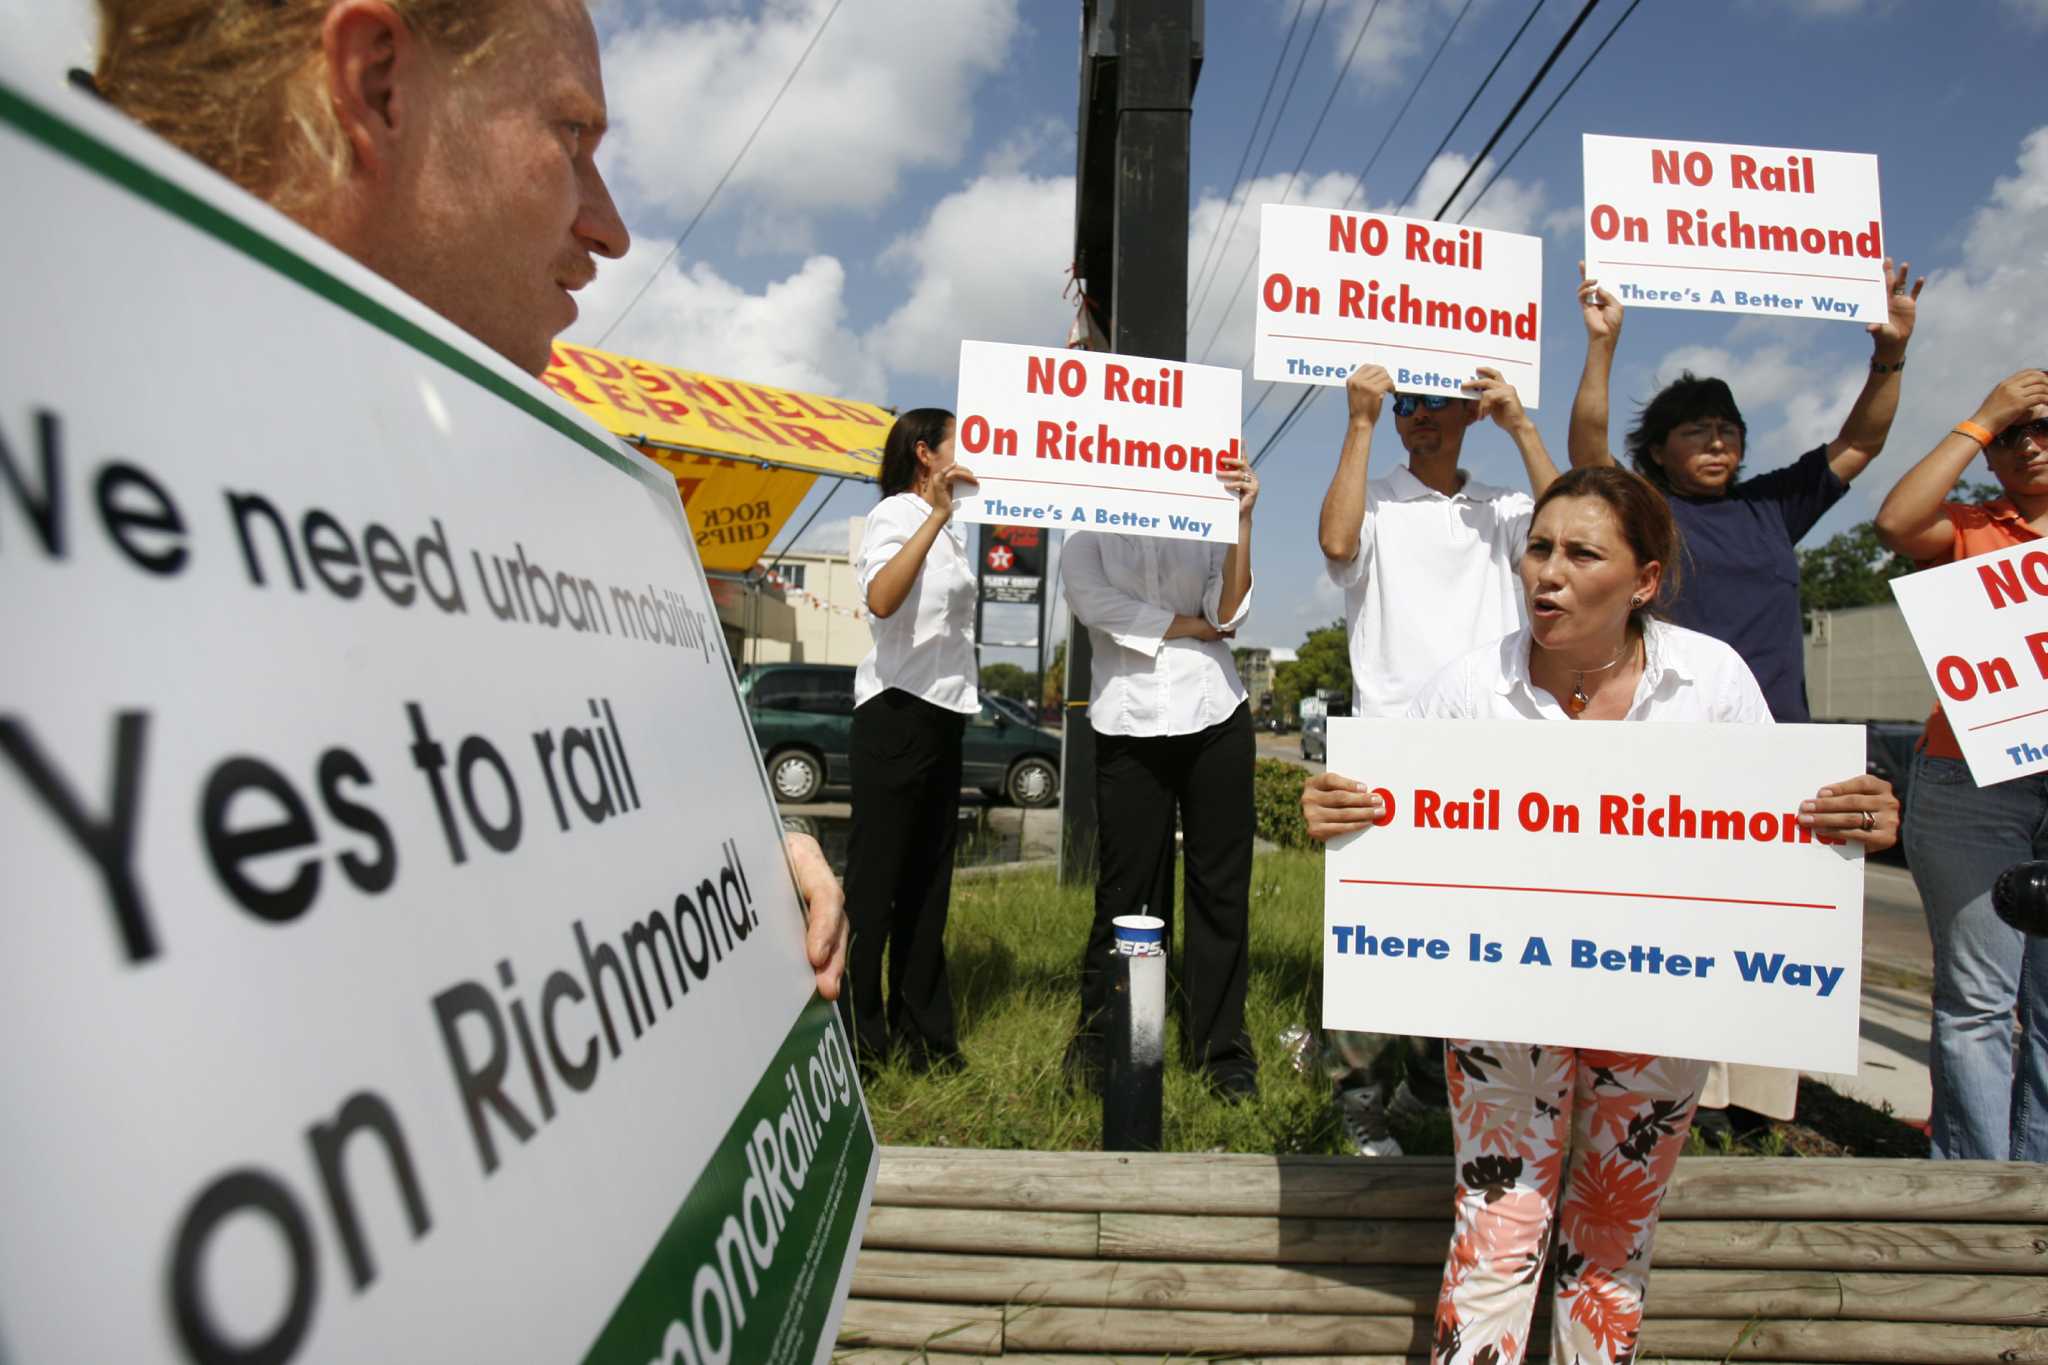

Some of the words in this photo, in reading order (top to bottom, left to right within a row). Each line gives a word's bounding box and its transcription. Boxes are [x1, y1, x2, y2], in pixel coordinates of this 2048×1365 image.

[1652, 149, 1713, 187] NO
[1731, 154, 1815, 194] Rail
[1329, 214, 1389, 257] NO
[1406, 223, 1483, 270] Rail
[1591, 204, 1649, 243] On
[1666, 209, 1882, 260] Richmond
[1263, 273, 1321, 315] On
[1338, 279, 1537, 342] Richmond
[1620, 284, 1701, 303] There's
[1710, 290, 1726, 305] A
[1735, 291, 1804, 311] Better
[1812, 296, 1859, 318] Way
[1027, 356, 1087, 398] NO
[1104, 363, 1184, 409] Rail
[1287, 358, 1356, 379] There'
[1398, 367, 1462, 389] Better
[539, 371, 849, 454] REPAIR
[961, 415, 1018, 457] On
[1036, 420, 1239, 475] Richmond
[984, 500, 1063, 521] There's
[1072, 507, 1087, 522] A
[1095, 508, 1160, 529] Better
[1169, 515, 1212, 537] Way
[222, 488, 468, 615] need
[471, 543, 611, 636] urban
[1936, 655, 2018, 701] On
[0, 709, 399, 968] Yes
[403, 700, 523, 866] to
[531, 697, 641, 833] rail
[1413, 788, 1500, 831] Rail
[1518, 792, 1580, 833] On
[1332, 924, 1451, 961] There
[1469, 933, 1504, 964] Is
[1519, 937, 1552, 968] A
[1570, 938, 1717, 978] Better
[1733, 951, 1846, 997] Way
[162, 1088, 434, 1365] on
[429, 836, 760, 1177] Richmond!
